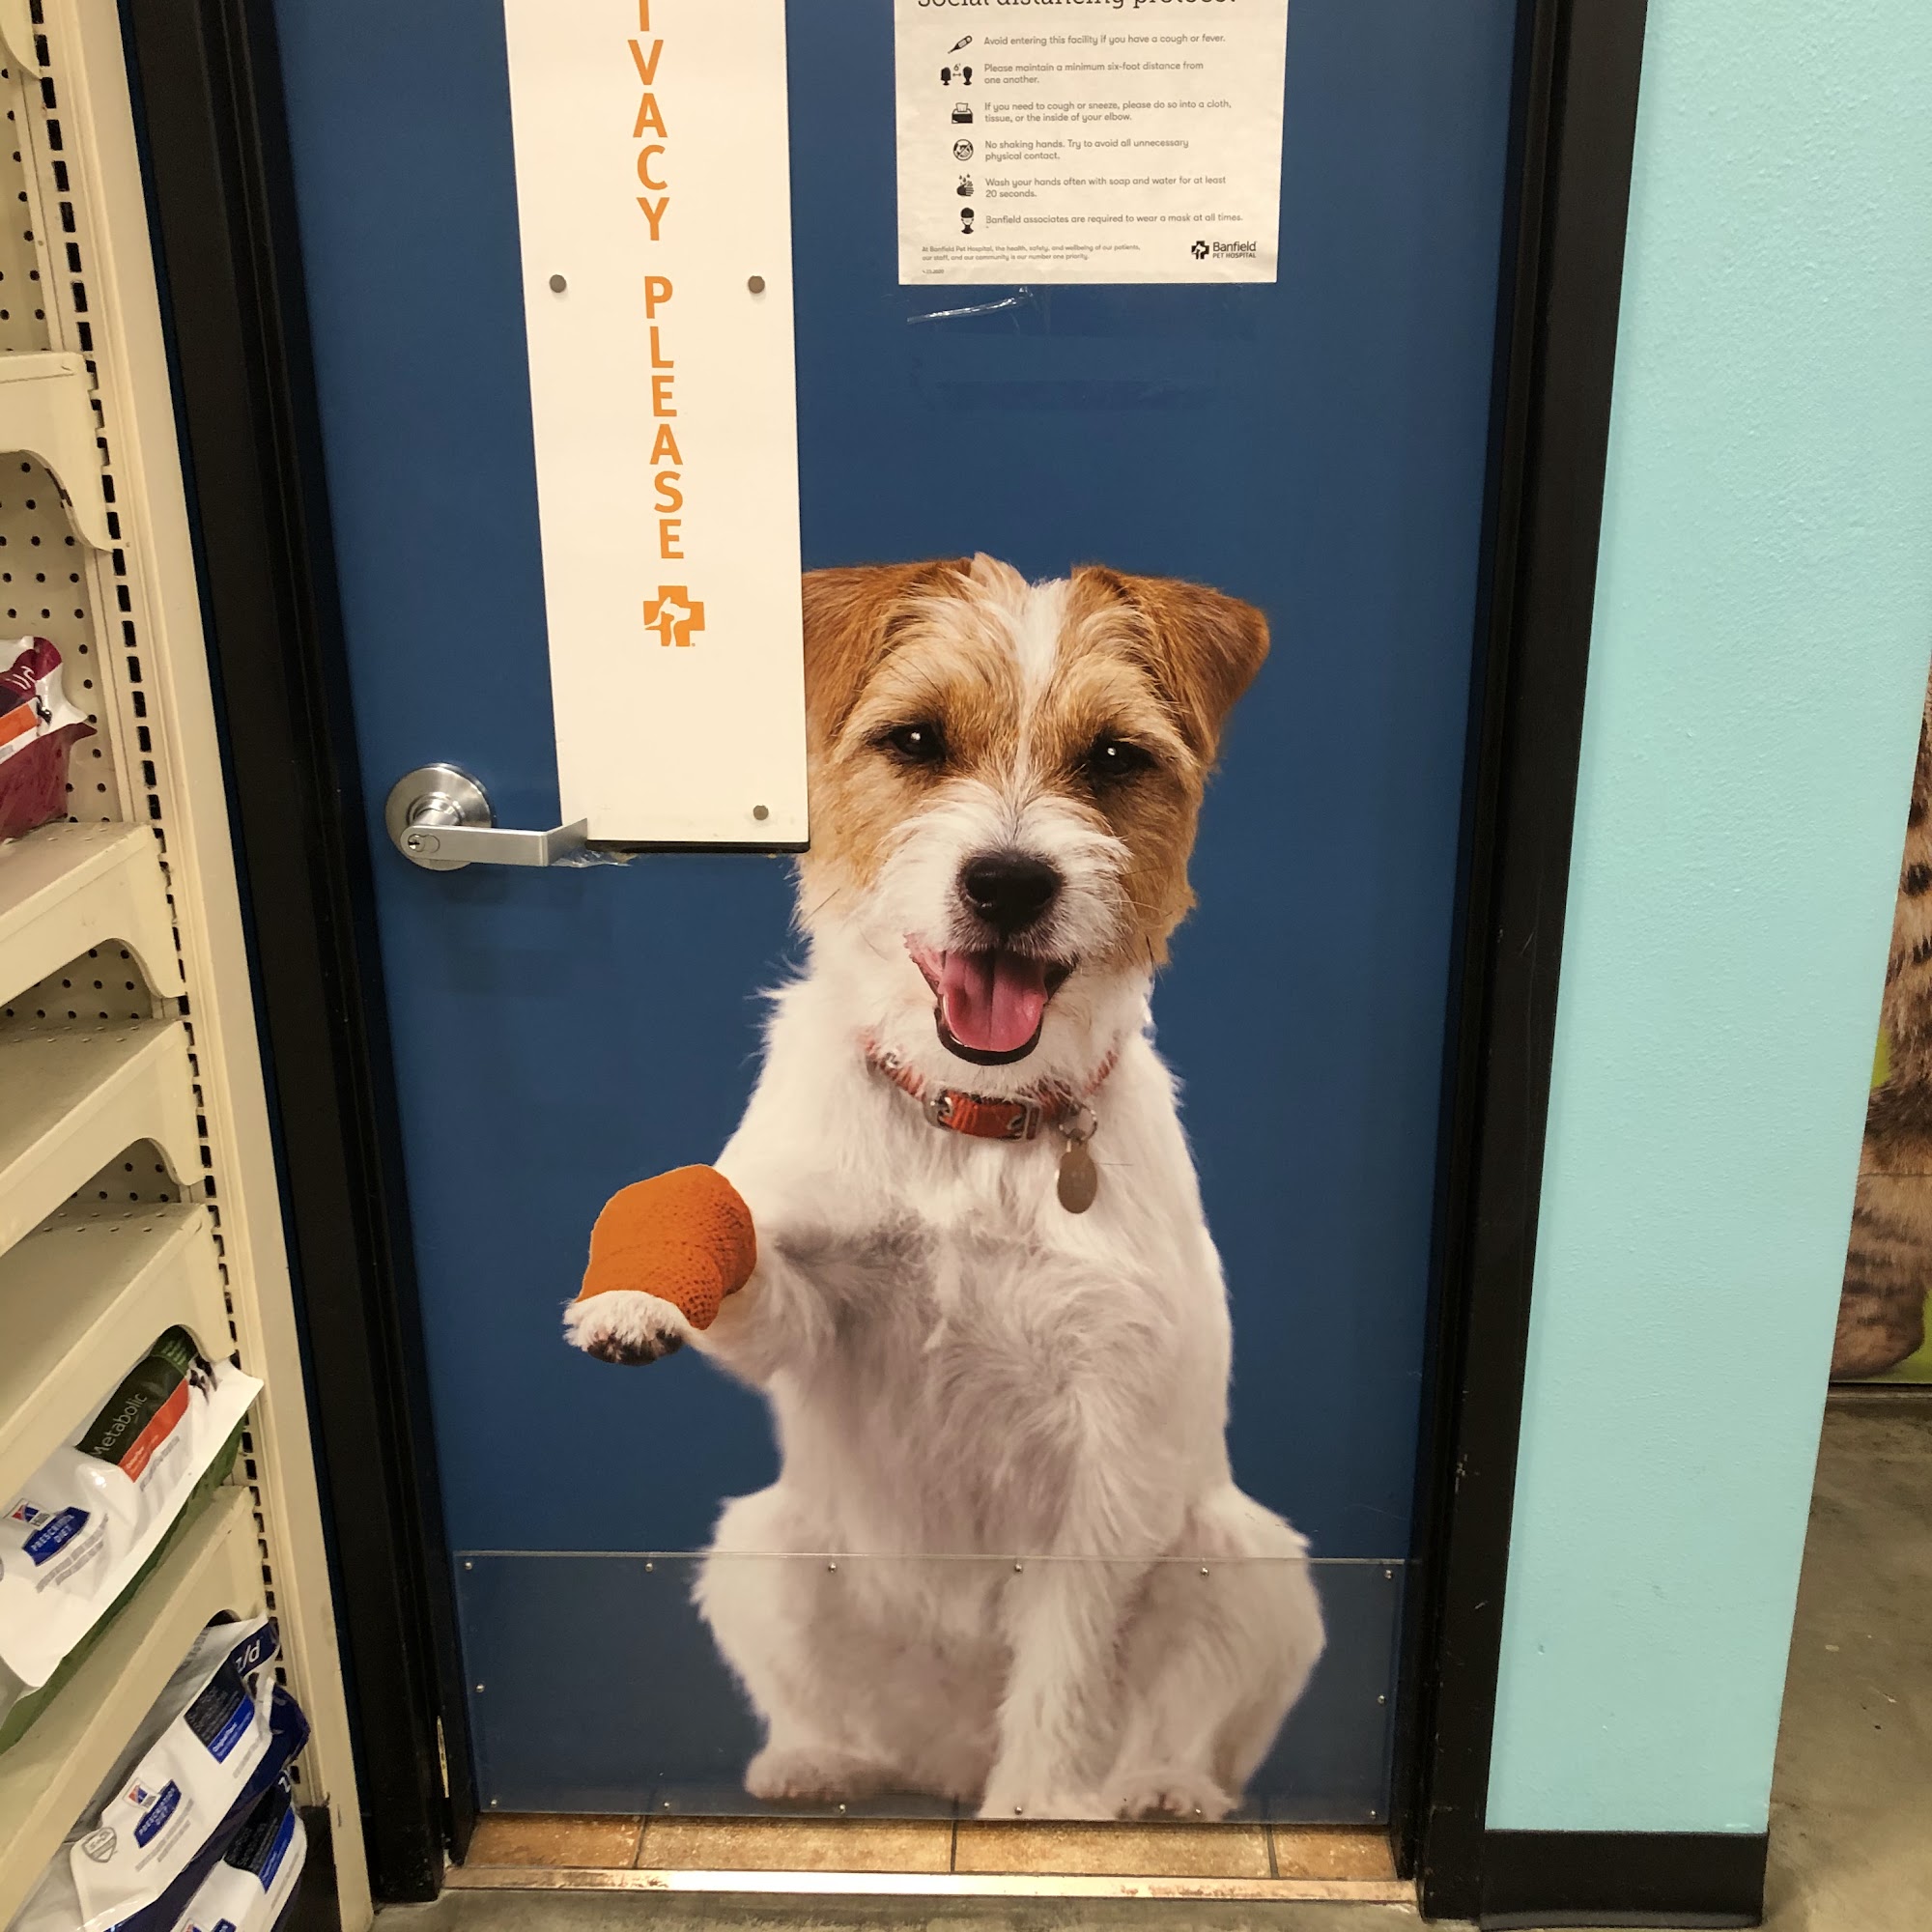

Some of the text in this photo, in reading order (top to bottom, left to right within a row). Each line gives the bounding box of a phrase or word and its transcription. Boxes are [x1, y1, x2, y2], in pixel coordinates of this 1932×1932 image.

[983, 36, 1009, 45] Avoid
[1009, 36, 1047, 46] entering
[1048, 35, 1066, 44] this
[1066, 35, 1098, 46] facility
[1099, 34, 1107, 43] if
[1108, 36, 1126, 45] you
[1127, 34, 1150, 43] have
[1159, 33, 1188, 44] cough
[1202, 33, 1226, 43] fever.
[983, 63, 1013, 72] Please
[1014, 63, 1055, 71] maintain
[1064, 62, 1105, 71] minimum
[1107, 61, 1141, 71] six-foot
[1142, 61, 1180, 71] distance
[1182, 60, 1204, 70] from
[1002, 74, 1039, 84] another.
[983, 101, 991, 111] If
[992, 103, 1010, 113] you
[1011, 101, 1034, 110] need
[1046, 100, 1075, 112] cough
[1088, 102, 1121, 111] sneeze,
[1122, 99, 1151, 111] please
[1152, 99, 1165, 108] do
[1179, 99, 1197, 108] into
[1206, 99, 1232, 108] cloth,
[983, 113, 1013, 124] tissue,
[1026, 112, 1041, 122] the
[1042, 112, 1069, 122] inside
[1070, 112, 1080, 121] of
[1081, 114, 1103, 124] your
[1103, 111, 1132, 121] elbow.
[984, 138, 1189, 151] No shaking hands. Try to avoid all unnecessary
[984, 151, 1061, 162] physical contact.
[984, 178, 1010, 186] Wash
[1010, 180, 1033, 189] your
[1034, 177, 1062, 186] hands
[1063, 176, 1087, 185] often
[1088, 177, 1107, 185] with
[1108, 178, 1131, 187] soap
[1131, 176, 1150, 185] and
[1179, 175, 1192, 185] for
[1205, 175, 1226, 185] least
[984, 188, 1037, 198] 20 seconds.
[985, 214, 1022, 224] Banfield
[1022, 214, 1069, 223] associates
[1087, 213, 1123, 224] required
[1167, 213, 1191, 222] mask
[1204, 213, 1215, 221] all
[1217, 213, 1243, 221] times.
[1065, 243, 1094, 252] wellbeing
[1114, 243, 1141, 252] patients,
[1213, 241, 1257, 251] Banfield
[643, 275, 684, 559] PLEASE
